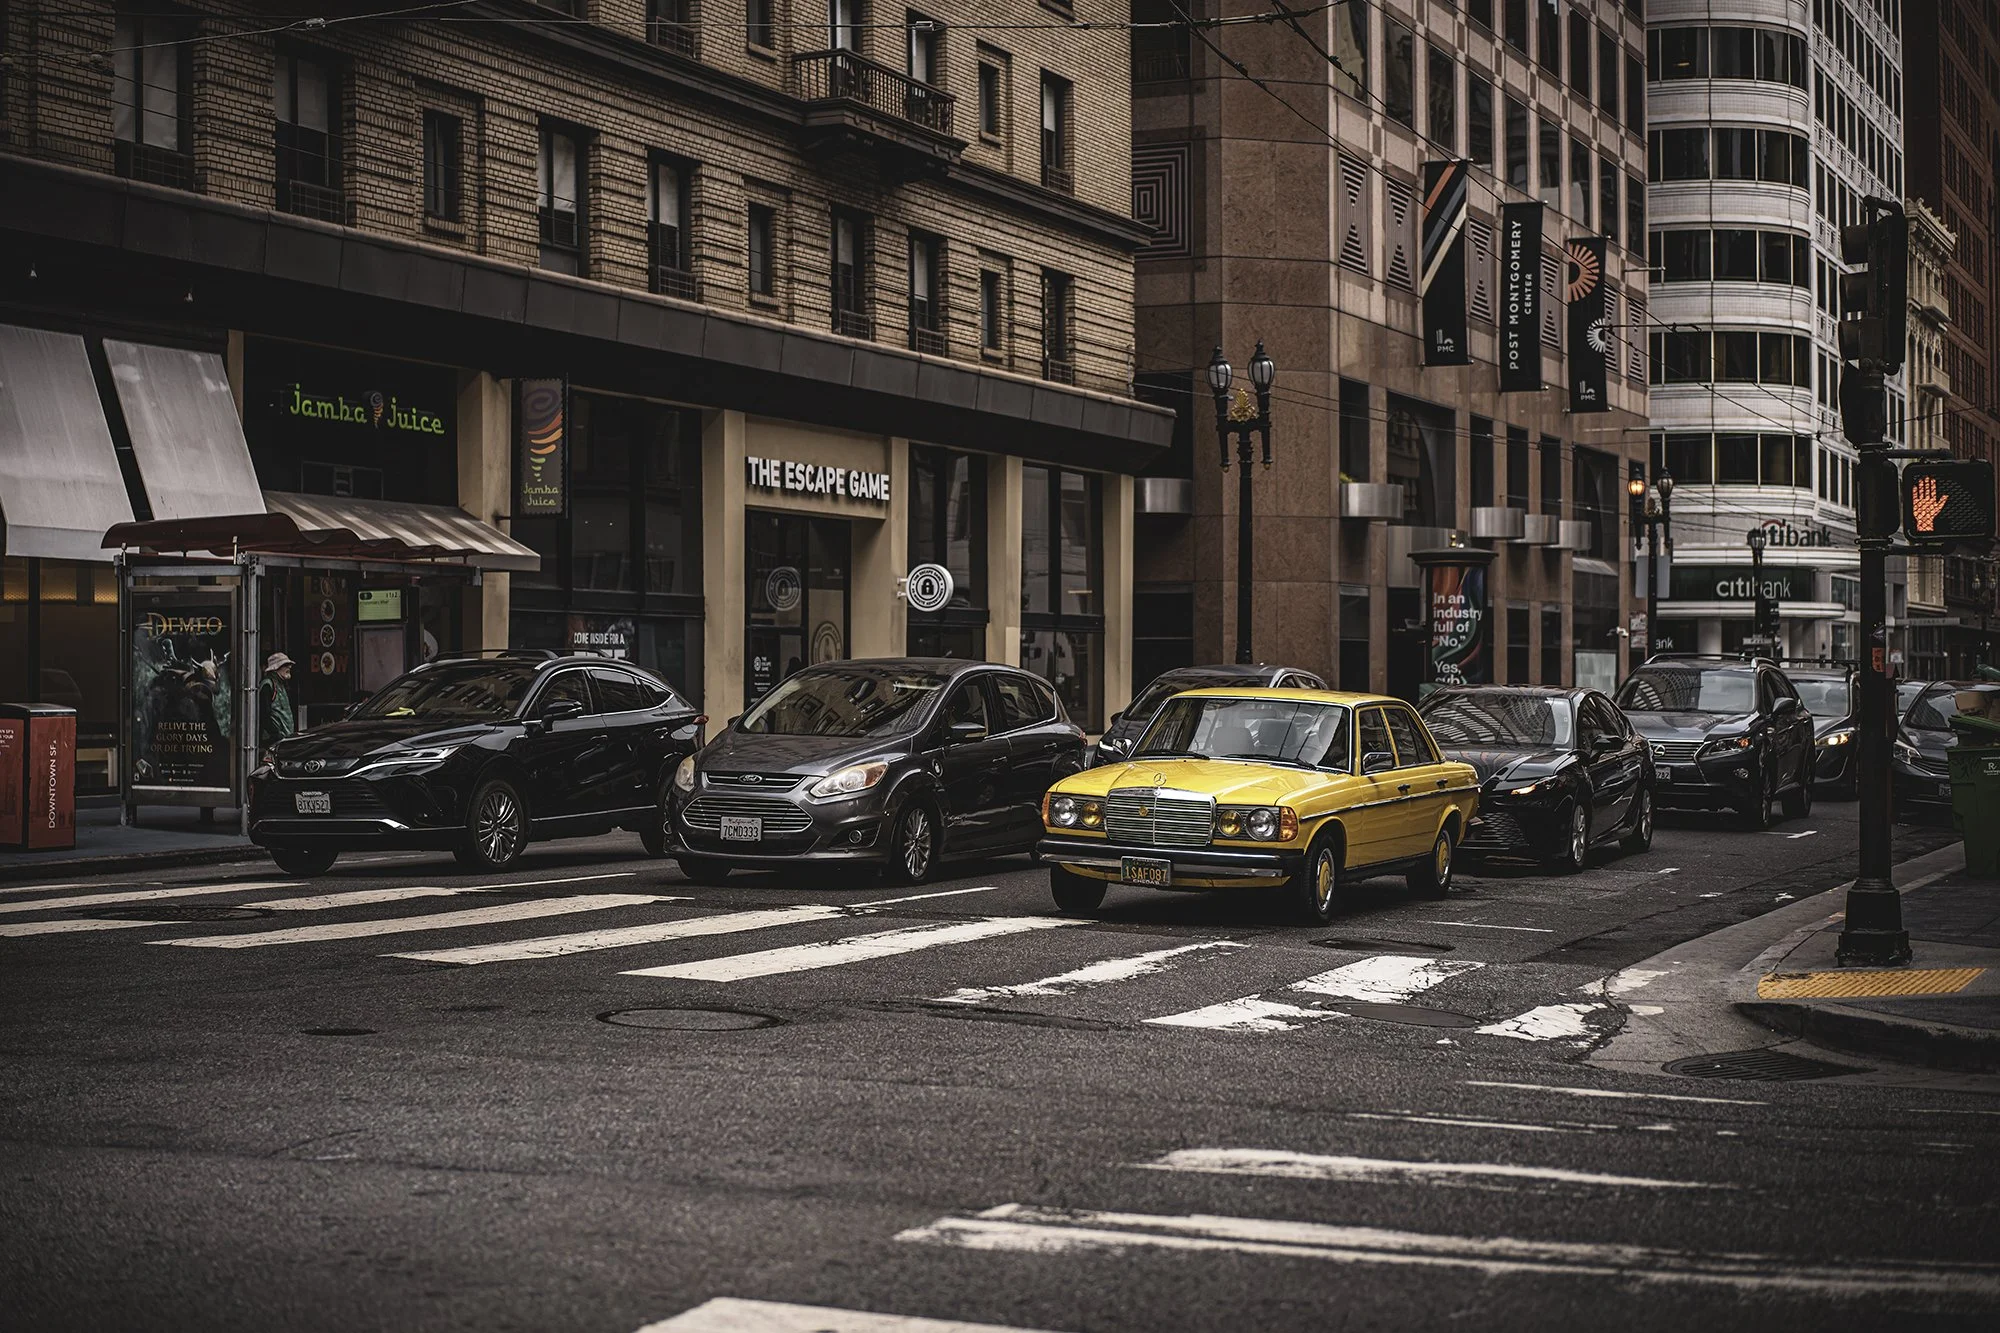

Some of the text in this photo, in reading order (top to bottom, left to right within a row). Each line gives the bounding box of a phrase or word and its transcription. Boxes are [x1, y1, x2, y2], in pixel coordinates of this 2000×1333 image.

[1508, 220, 1522, 370] POST MONTGOMERY
[1523, 273, 1533, 315] CENTER
[1436, 345, 1455, 353] PMC
[747, 456, 890, 500] THE ESCAPE GAME
[1432, 592, 1465, 604] In an
[1432, 606, 1483, 621] industry
[1432, 621, 1470, 633] full of
[1434, 660, 1462, 674] Yes,
[158, 722, 207, 731] RELIVE THE
[155, 733, 208, 742] GLORY DAYS
[180, 744, 213, 754] TRYING
[48, 759, 57, 829] DOWNTOWN
[1125, 866, 1168, 882] 1SAF087
